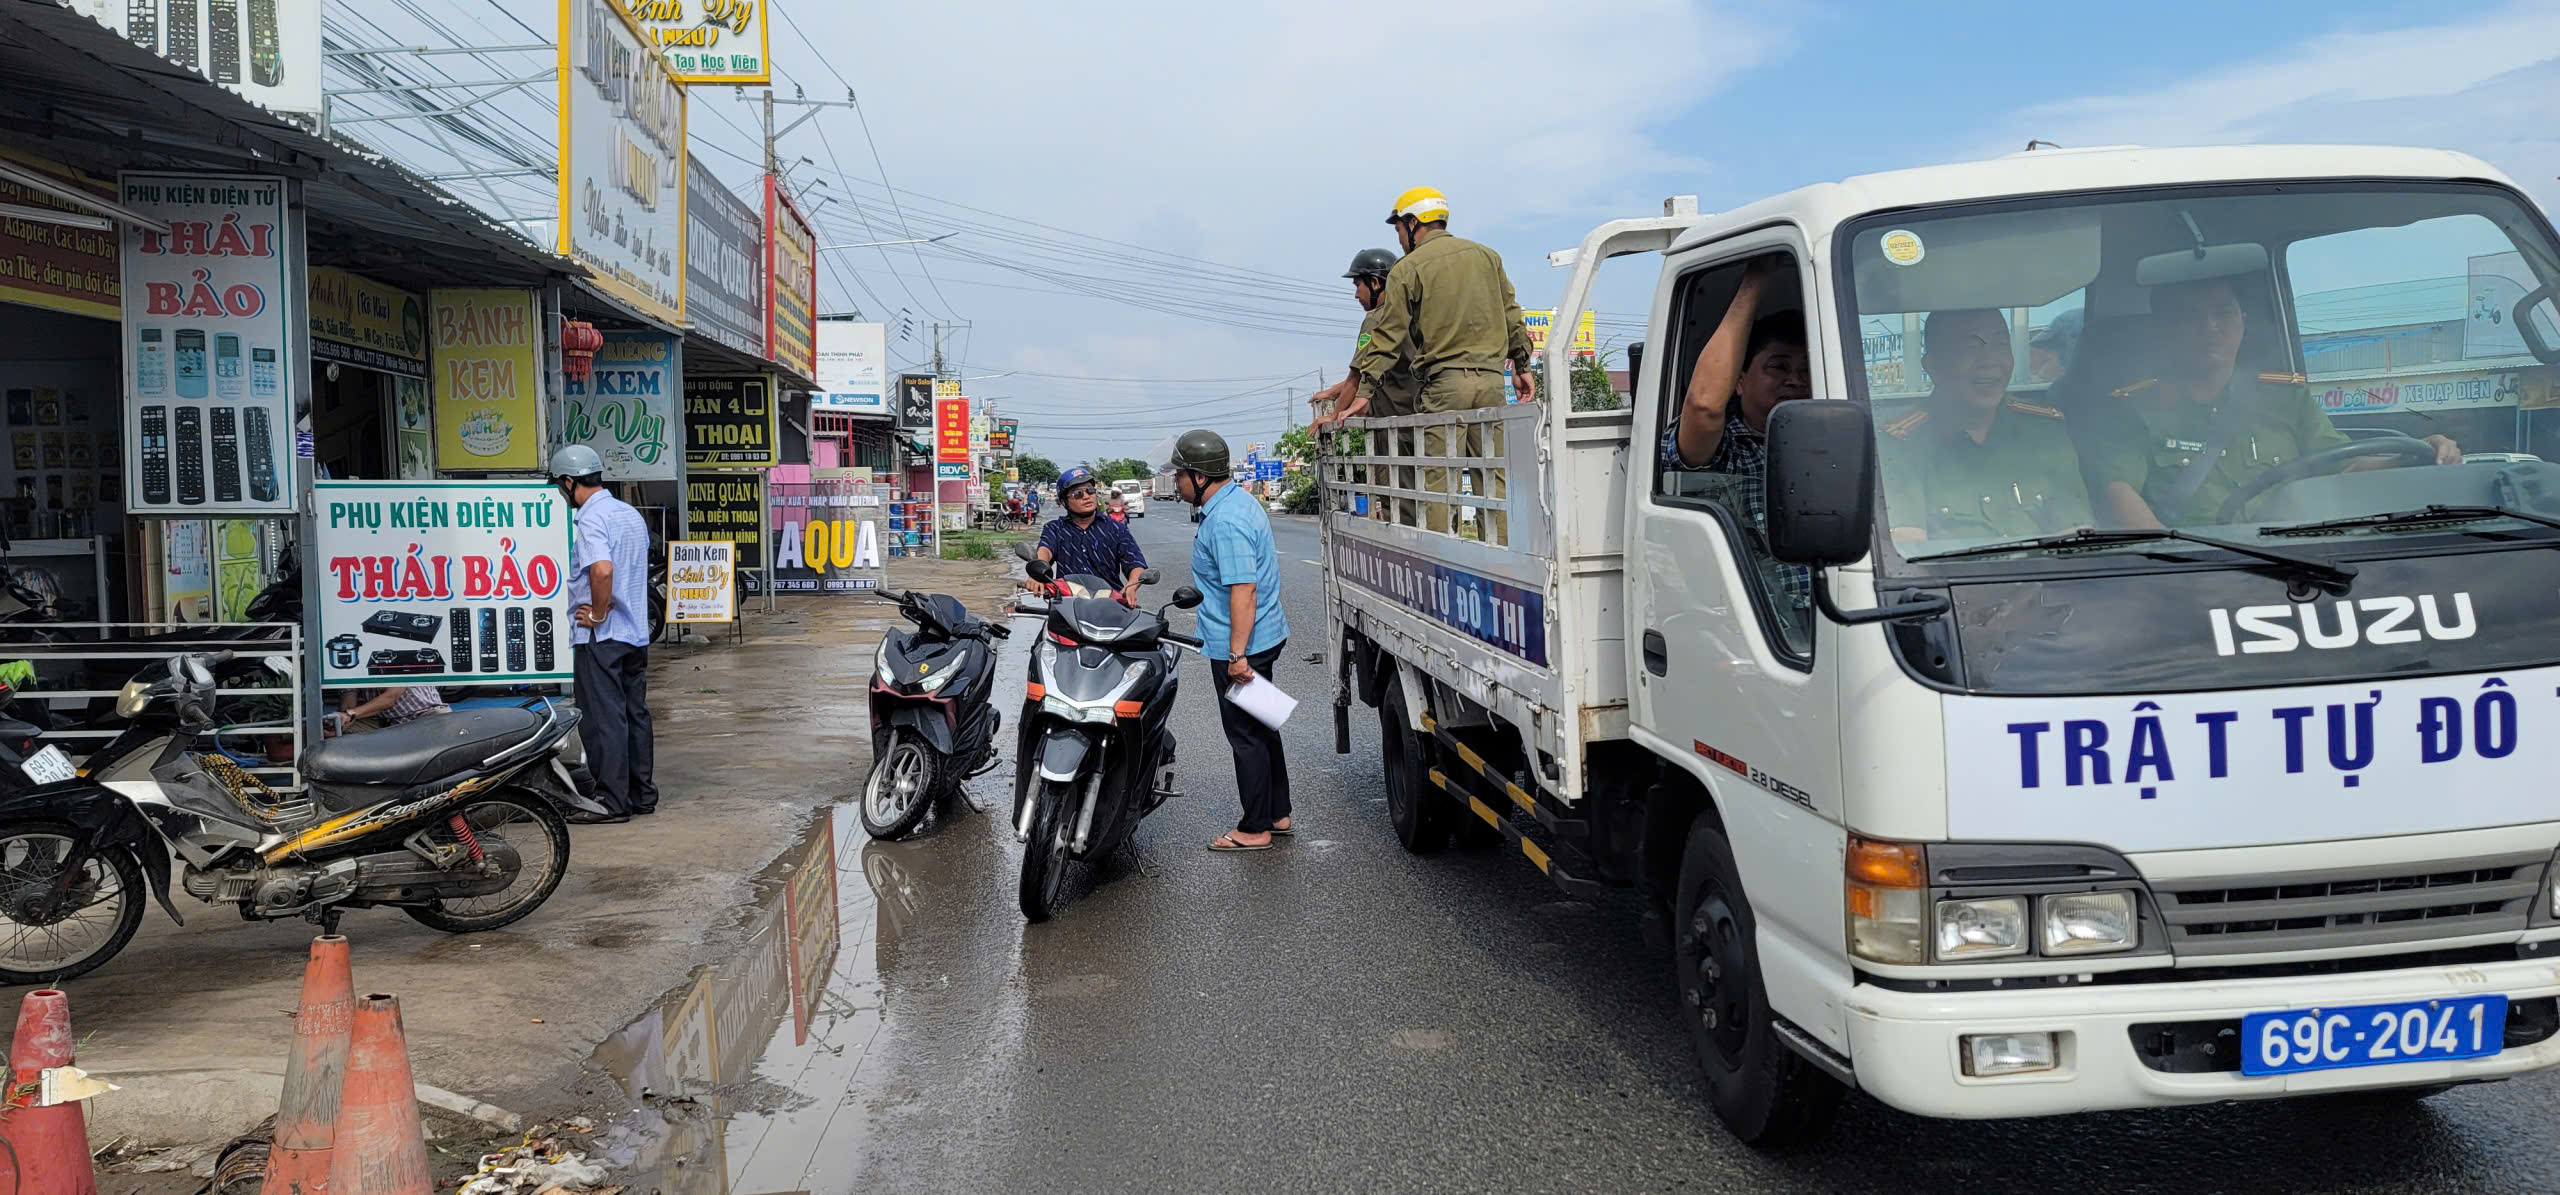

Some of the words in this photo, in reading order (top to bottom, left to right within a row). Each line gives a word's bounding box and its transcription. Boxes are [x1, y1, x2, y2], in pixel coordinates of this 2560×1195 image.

[674, 54, 696, 72] Tạo
[701, 54, 725, 72] Học
[730, 54, 758, 70] Viên
[127, 184, 161, 206] PHỤ
[166, 183, 202, 207] KIỆN
[210, 184, 249, 208] ĐIỆN
[254, 184, 276, 207] TỬ
[134, 211, 275, 258] THÁI
[688, 212, 719, 286] MINH
[750, 257, 758, 307] 4
[66, 266, 82, 292] pin
[146, 267, 266, 320] BẢO
[436, 299, 526, 347] BÁNH
[449, 358, 517, 401] KEM
[595, 370, 661, 395] KEM
[709, 379, 734, 392] ĐỘNG
[2405, 384, 2424, 403] XE
[2425, 384, 2453, 405] ĐẠP
[2456, 377, 2490, 404] ĐIỆN
[728, 398, 740, 414] 4
[598, 398, 668, 465] Vy
[694, 424, 763, 449] THOẠI
[939, 465, 960, 475] BIDV
[687, 483, 716, 502] MINH
[719, 477, 751, 507] QUÂN
[753, 482, 759, 502] 4
[330, 502, 382, 534] PHỤ
[390, 496, 449, 534] KIỆN
[457, 496, 514, 534] ĐIỆN
[521, 493, 553, 528] TỬ
[688, 506, 705, 523] SỬA
[707, 508, 729, 526] ĐIỆN
[731, 510, 758, 526] THOẠI
[736, 529, 758, 544] HÌNH
[776, 519, 881, 575] AQUA
[330, 542, 454, 602] THÁI
[461, 537, 562, 601] BẢO
[674, 545, 701, 563] Bánh
[704, 545, 728, 563] Kem
[1339, 541, 1368, 585] QUẢN
[1368, 552, 1383, 588] LÝ
[1387, 560, 1424, 607] TRẬT
[1427, 574, 1450, 625] TỰ
[1456, 582, 1481, 629] ĐÔ
[1489, 596, 1526, 658] THỊ
[2209, 592, 2477, 656] ISUZU
[2007, 700, 2239, 800] TRẬT
[2272, 690, 2382, 788] TỰ
[2417, 677, 2518, 765] ĐÔ
[1770, 777, 1818, 812] DIESEL
